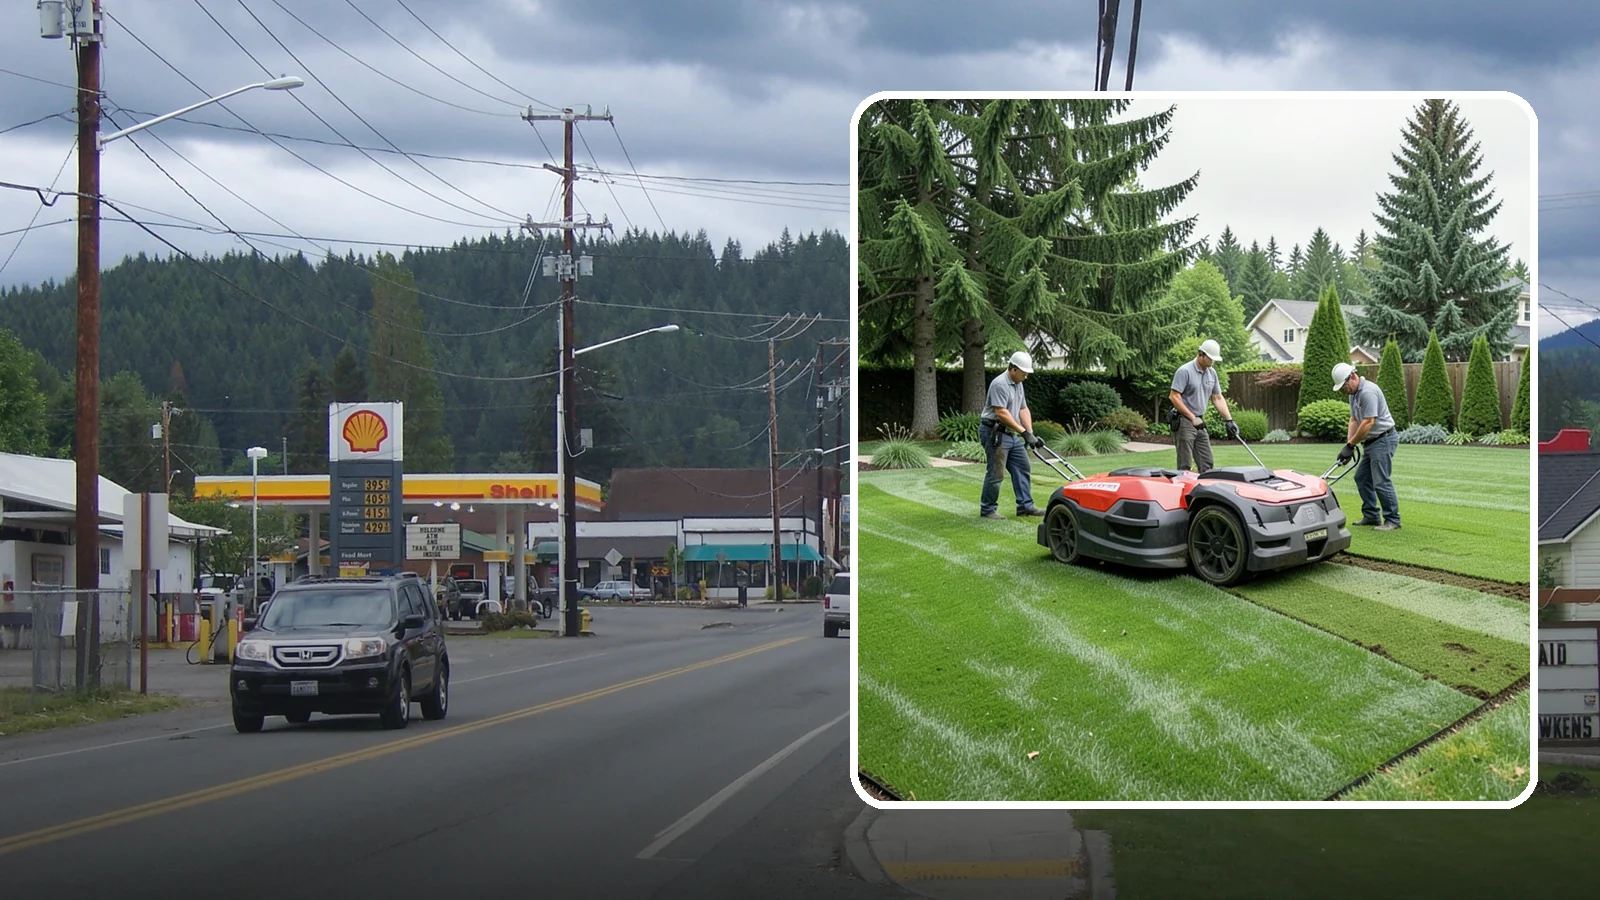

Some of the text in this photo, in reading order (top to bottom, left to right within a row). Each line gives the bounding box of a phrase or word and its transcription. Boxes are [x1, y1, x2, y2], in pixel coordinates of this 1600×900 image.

[365, 480, 384, 490] 395
[490, 484, 547, 499] Shell
[365, 494, 384, 504] 405
[365, 508, 384, 518] 415
[365, 522, 384, 532] 429
[1538, 643, 1566, 666] AID
